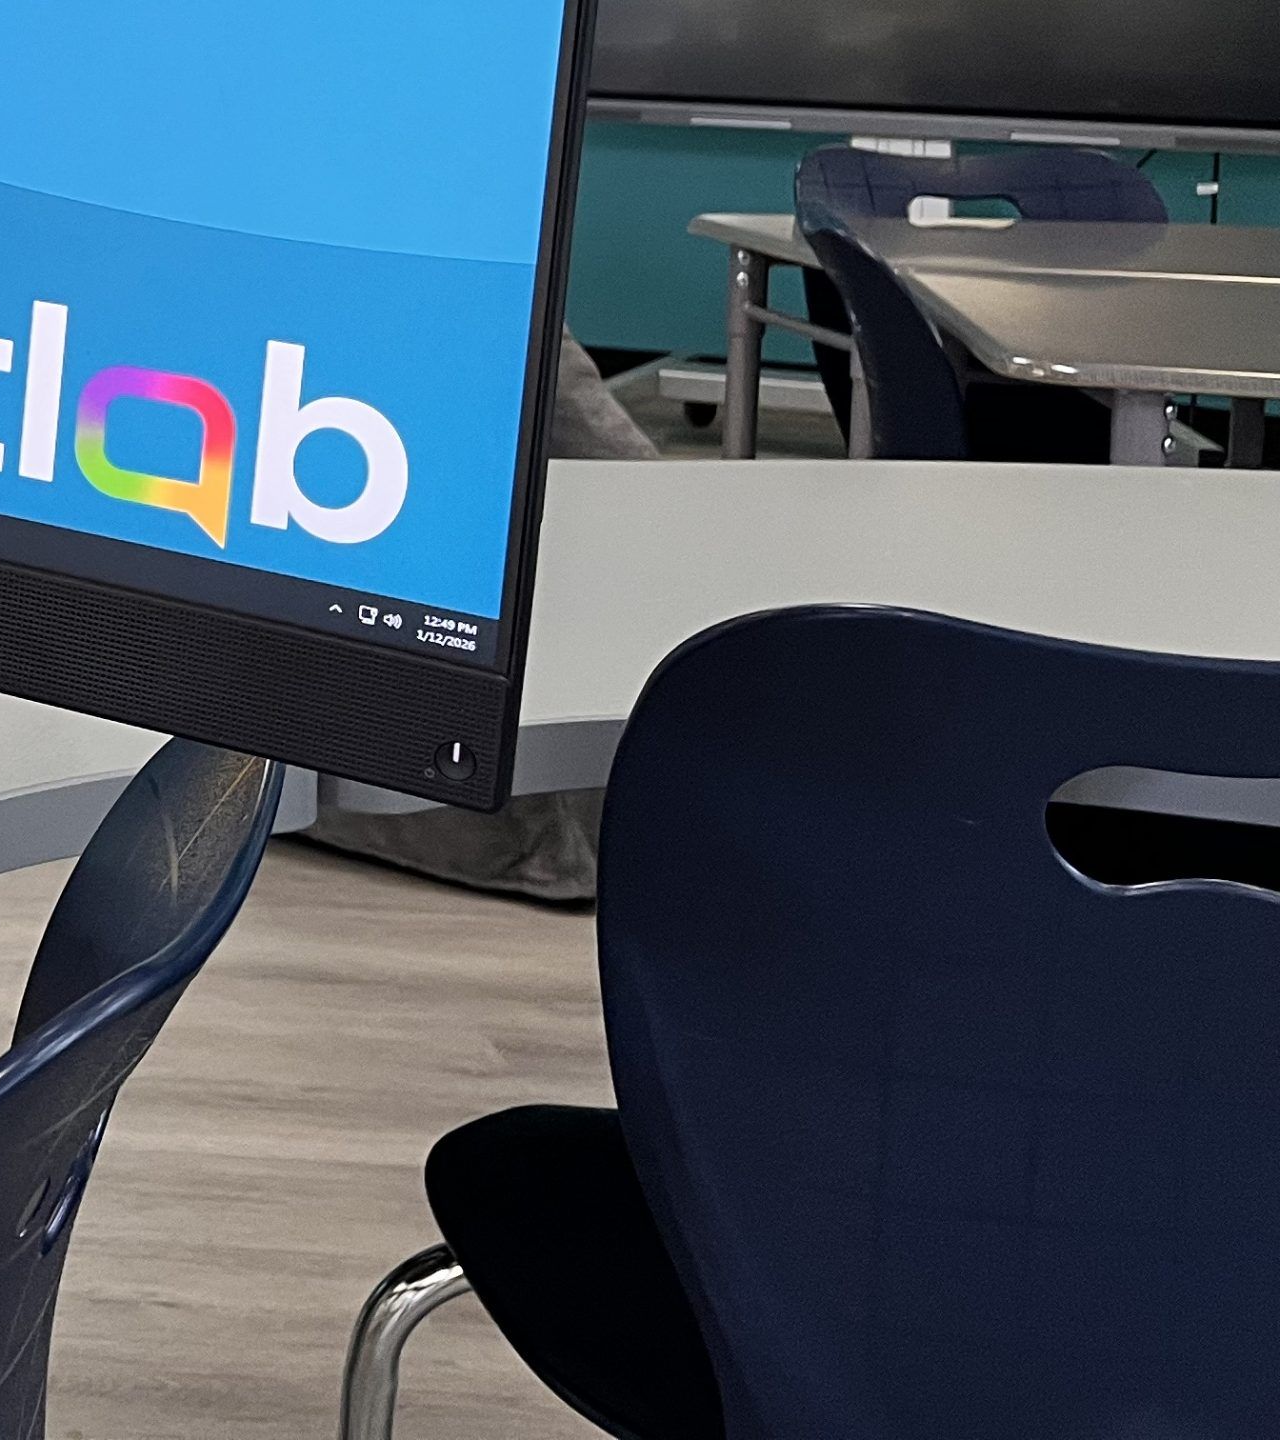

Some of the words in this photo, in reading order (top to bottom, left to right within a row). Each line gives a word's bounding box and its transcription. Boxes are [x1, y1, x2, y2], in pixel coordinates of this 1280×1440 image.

[423, 614, 456, 631] 12:49
[457, 621, 478, 636] PM
[416, 629, 477, 651] 1/12/2026
